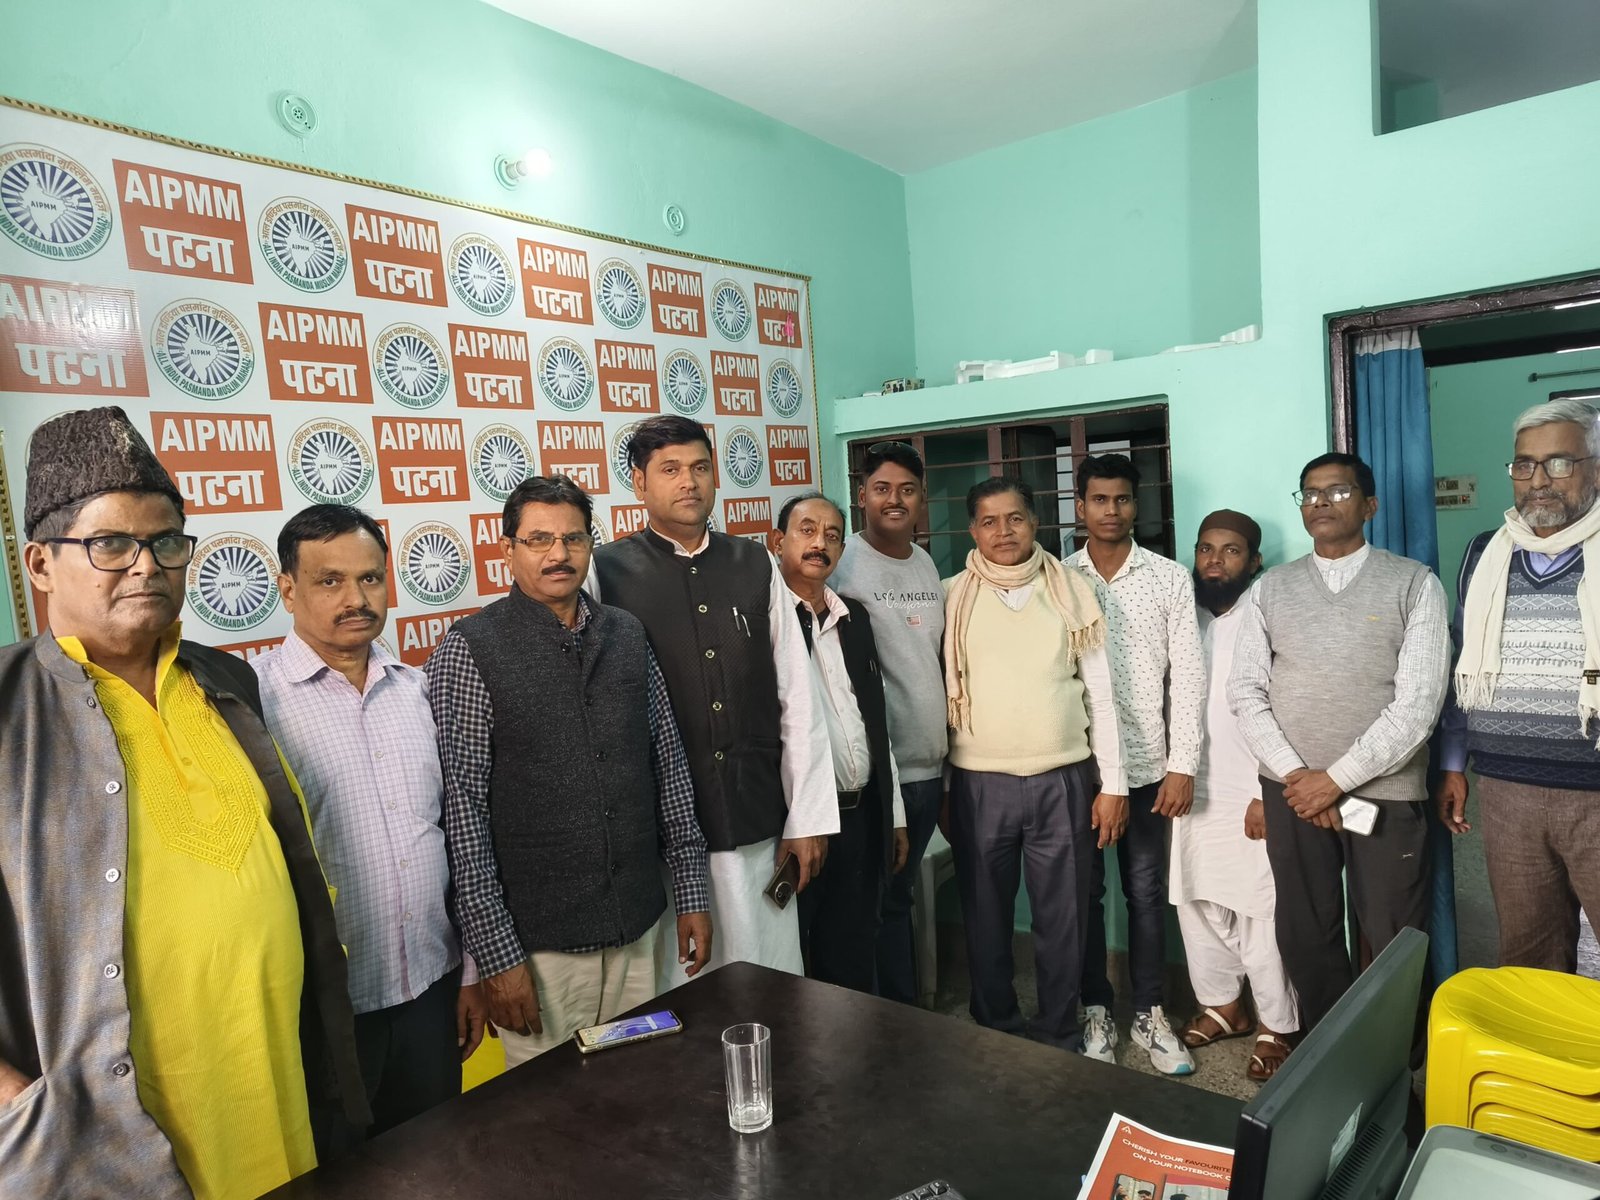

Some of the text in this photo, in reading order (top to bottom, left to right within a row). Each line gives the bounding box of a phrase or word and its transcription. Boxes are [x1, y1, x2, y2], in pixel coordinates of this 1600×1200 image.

[30, 200, 57, 211] AIPMM
[124, 169, 241, 222] AIPMM
[17, 232, 65, 258] PASMANDA
[64, 236, 95, 258] MUSLIM
[90, 217, 108, 245] MAHAAZ
[353, 211, 439, 254] AIPMM
[140, 225, 235, 275] पटना
[523, 244, 587, 280] AIPMM
[263, 244, 273, 256] ALL
[269, 256, 283, 273] INDIA
[282, 271, 315, 290] PASMANDA
[364, 258, 434, 300] पटना
[651, 269, 702, 298] AIPMM
[531, 284, 583, 319] पटना
[758, 288, 798, 312] AIPMM
[267, 310, 363, 348] AIPMM
[658, 304, 699, 333] पटना
[455, 330, 527, 362] AIPMM
[599, 344, 655, 371] AIPMM
[14, 342, 126, 388] पटना
[156, 352, 252, 397] ALL INDIA PASMANDA MUSLIM MAHAAZ
[279, 359, 357, 397] पटना
[714, 355, 758, 378] AIPMM
[464, 372, 522, 404] पटना
[606, 381, 651, 408] पटना
[719, 387, 755, 412] पटना
[160, 418, 271, 452] AIPMM
[380, 422, 462, 450] AIPMM
[542, 425, 604, 450] AIPMM
[769, 429, 808, 449] AIPMM
[292, 469, 301, 480] ALL
[297, 480, 312, 495] INDIA
[390, 466, 457, 497] पटना
[774, 459, 806, 481] पटना
[174, 470, 264, 507] पटना
[615, 508, 650, 533] AIP
[727, 500, 770, 524] AIPMM
[189, 583, 278, 628] ALL INDIA PASMANDA MUSLIM MAHAAZ
[403, 614, 470, 651] AIP
[1122, 1138, 1231, 1173] CHERISH YOUR FAVOURITE
[1132, 1152, 1147, 1161] ON
[1148, 1158, 1173, 1169] YOUR
[1174, 1165, 1223, 1180] NOTEBOOK
